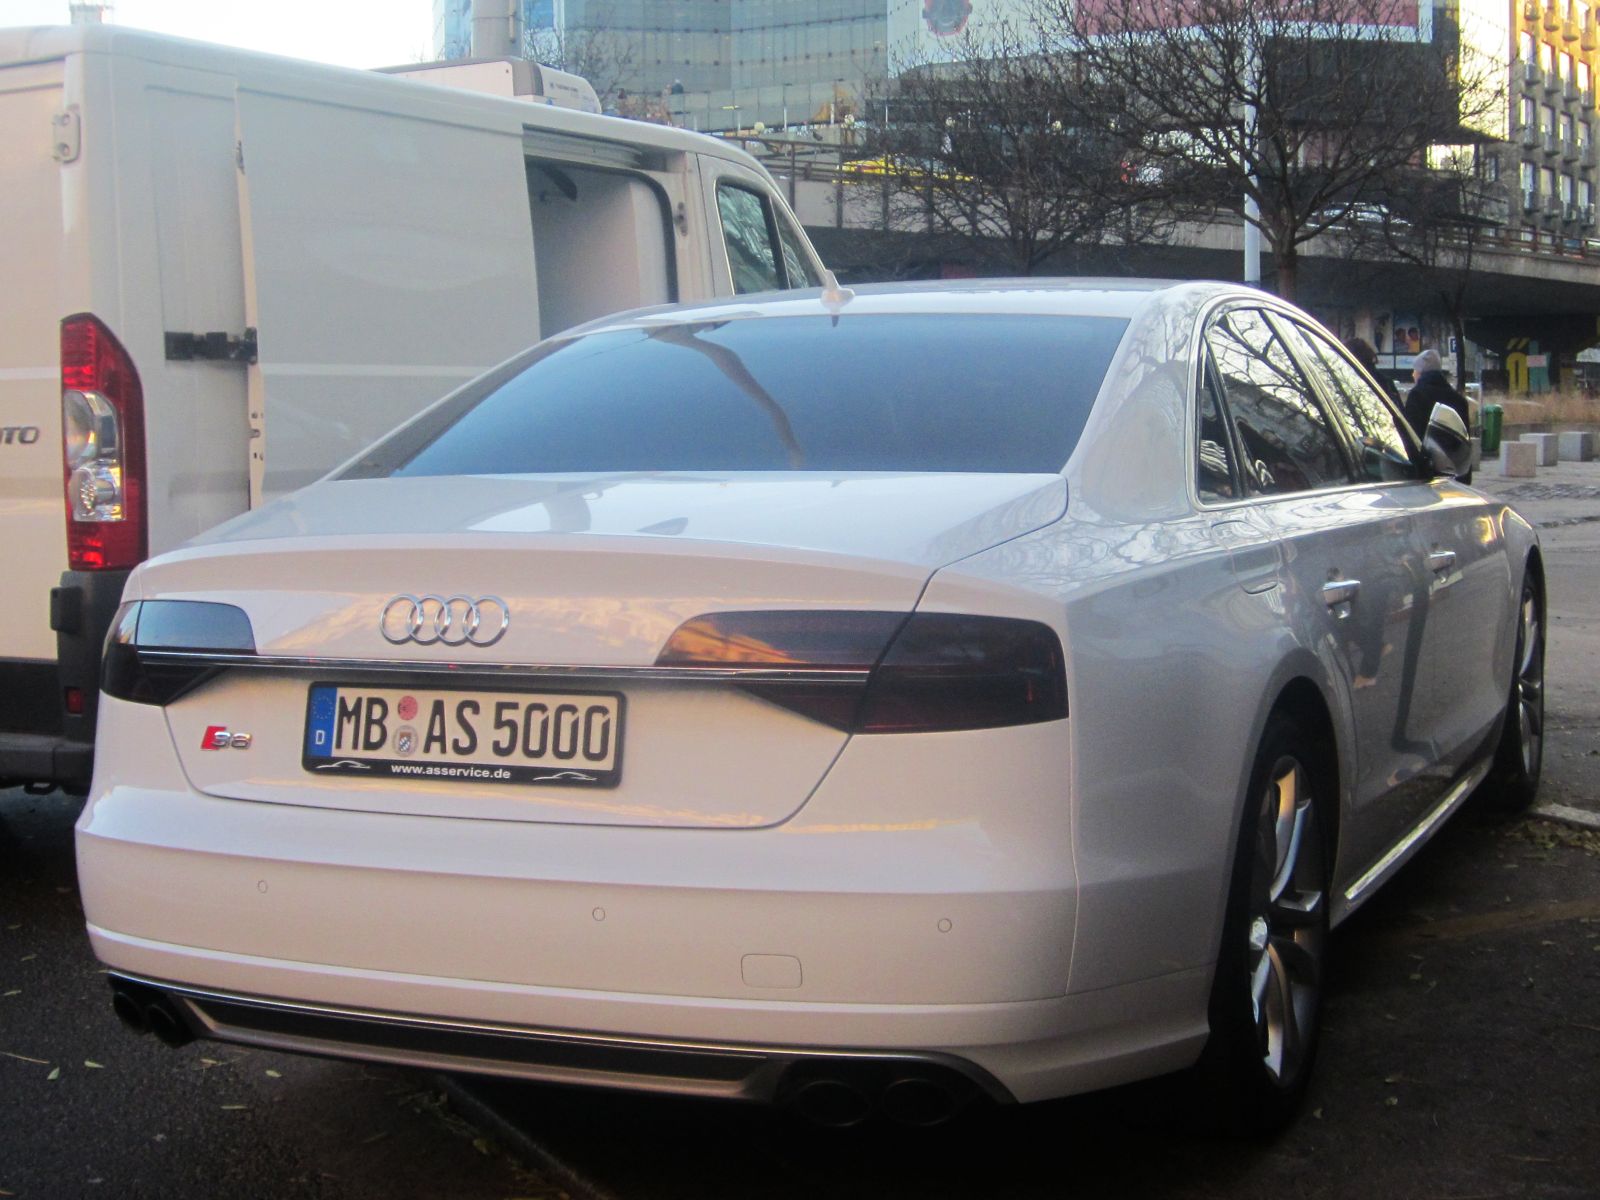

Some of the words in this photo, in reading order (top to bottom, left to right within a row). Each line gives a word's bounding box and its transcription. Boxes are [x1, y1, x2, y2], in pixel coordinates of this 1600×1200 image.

[0, 426, 40, 444] TO
[315, 729, 326, 745] D
[335, 696, 389, 750] MB
[423, 699, 481, 755] AS
[492, 701, 611, 761] 5000
[391, 764, 511, 779] www.asservice.de
